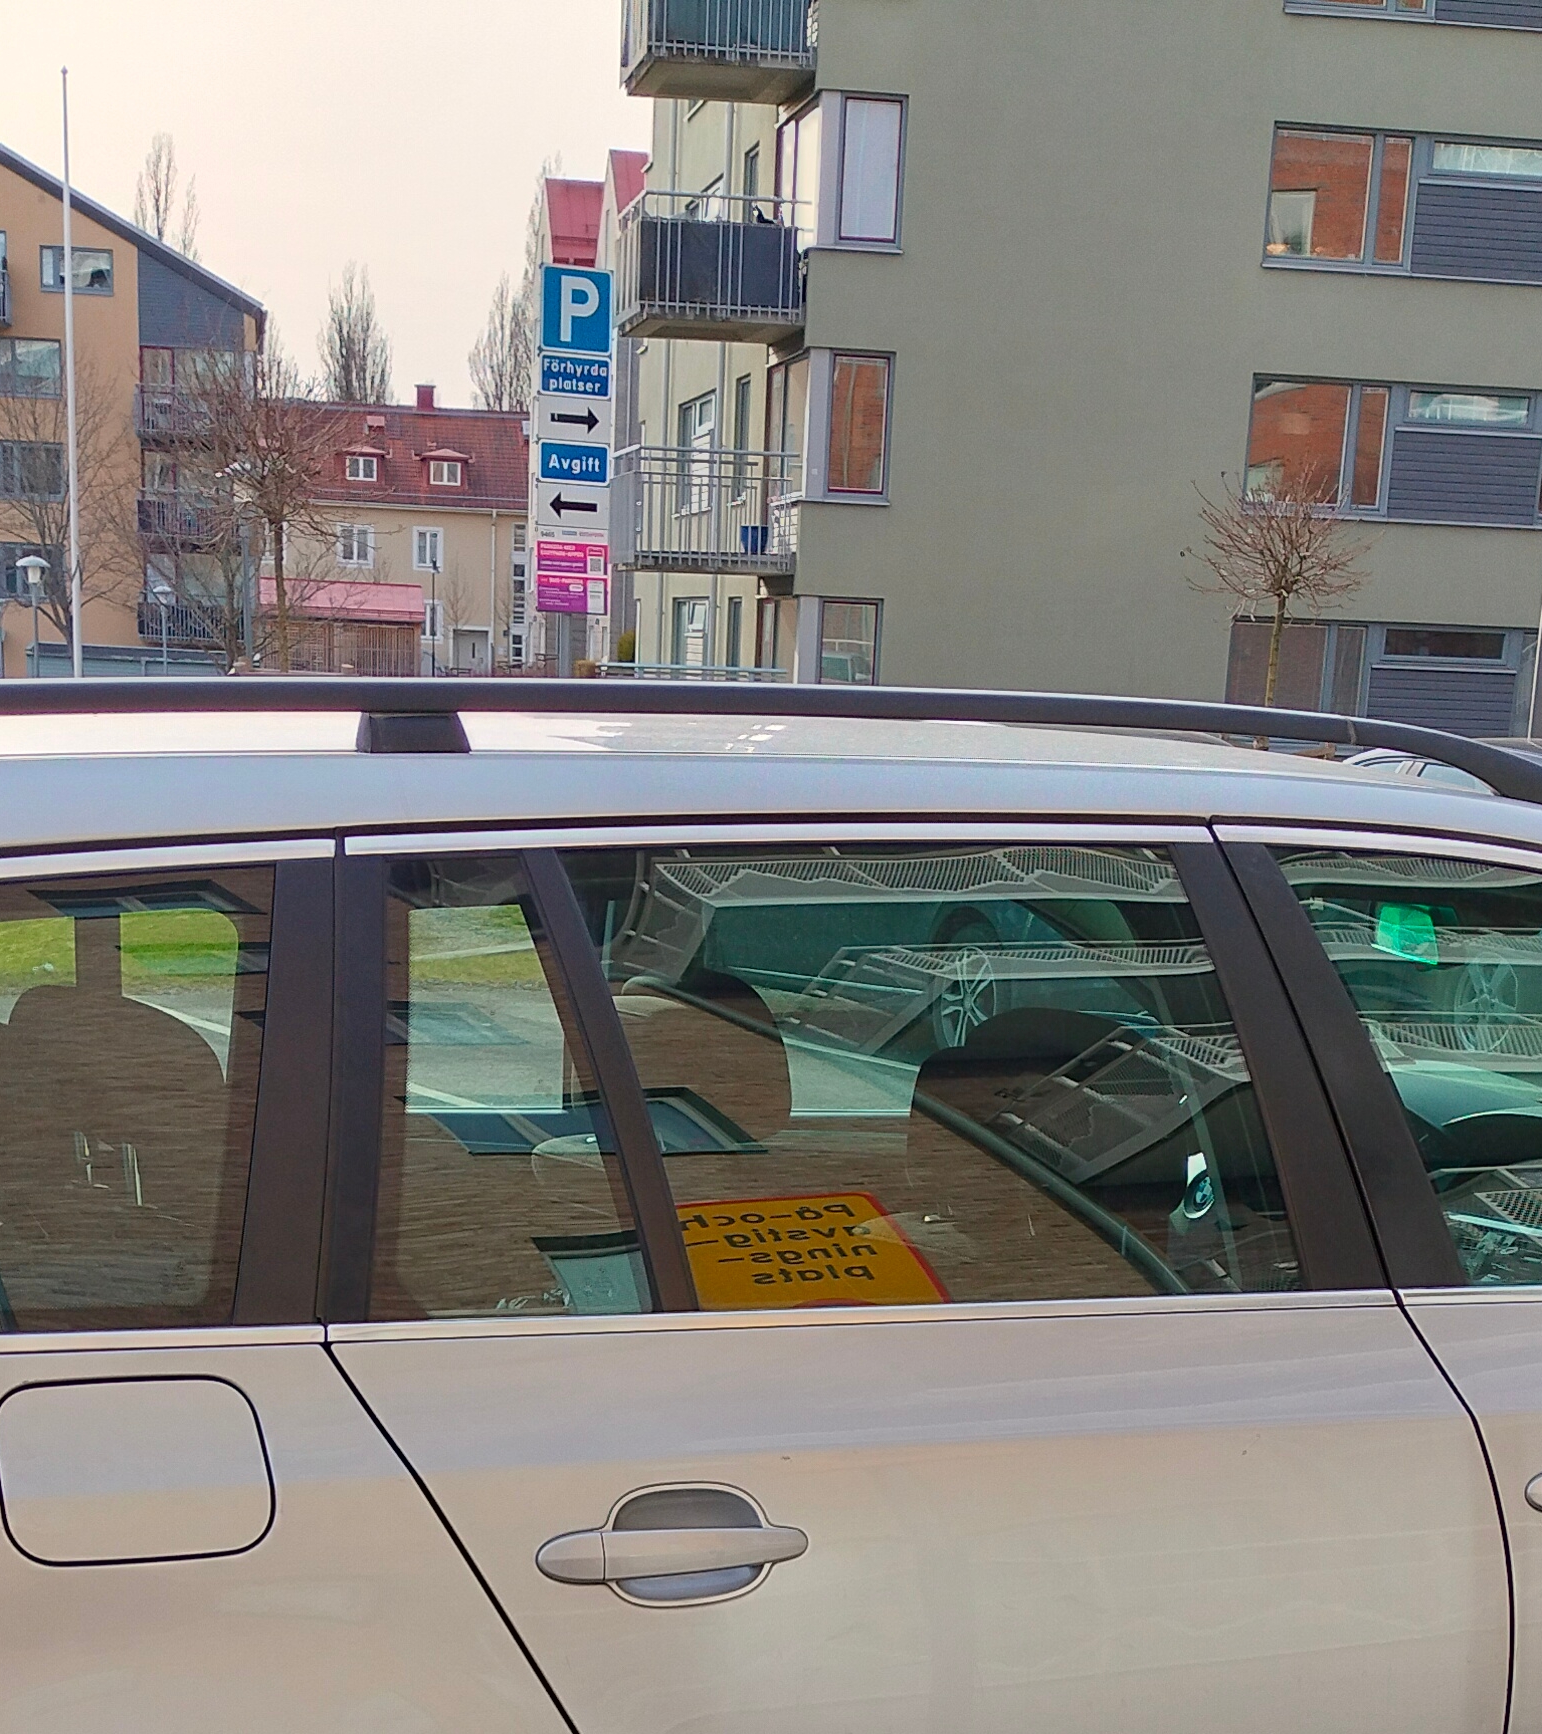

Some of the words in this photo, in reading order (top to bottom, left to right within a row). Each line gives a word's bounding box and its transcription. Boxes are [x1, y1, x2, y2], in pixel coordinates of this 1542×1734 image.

[560, 274, 600, 343] P
[543, 357, 608, 378] Förhyrda
[548, 377, 602, 394] platser
[548, 453, 601, 474] Avgift
